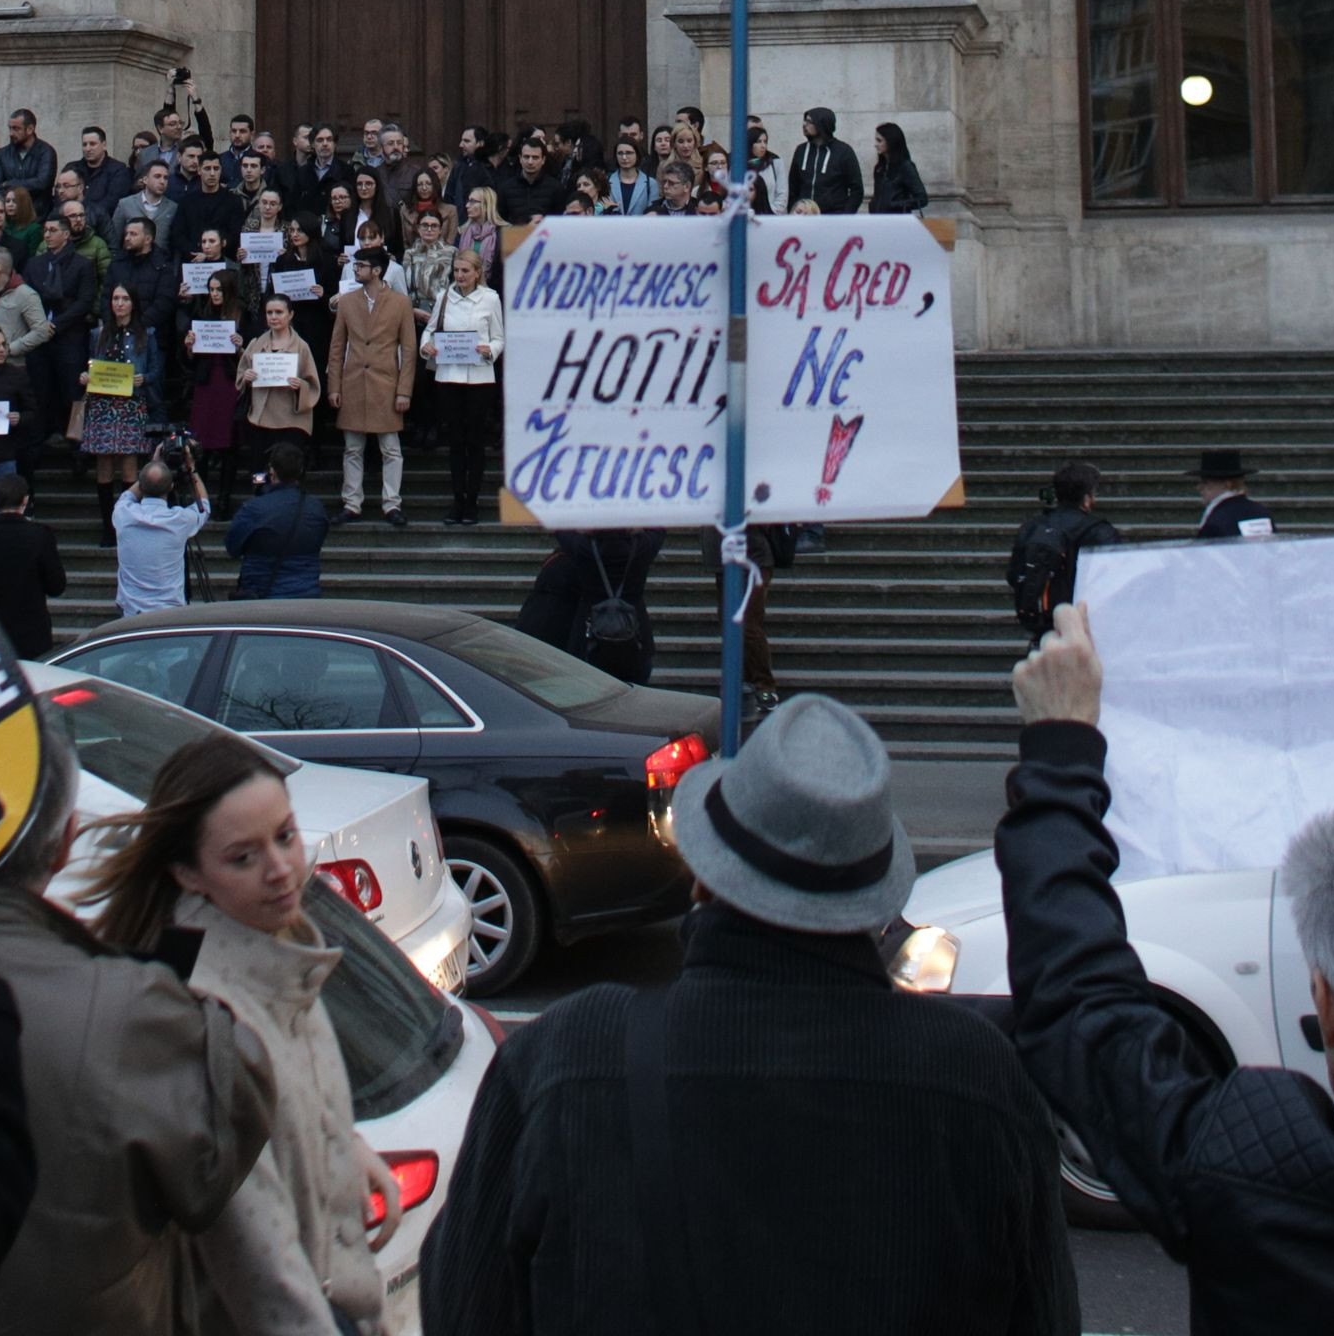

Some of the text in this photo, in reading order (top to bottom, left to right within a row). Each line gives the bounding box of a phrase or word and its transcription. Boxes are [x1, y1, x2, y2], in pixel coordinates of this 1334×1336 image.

[756, 235, 817, 320] SĂ
[782, 325, 864, 407] NE
[510, 407, 715, 504] JEFUIESC
